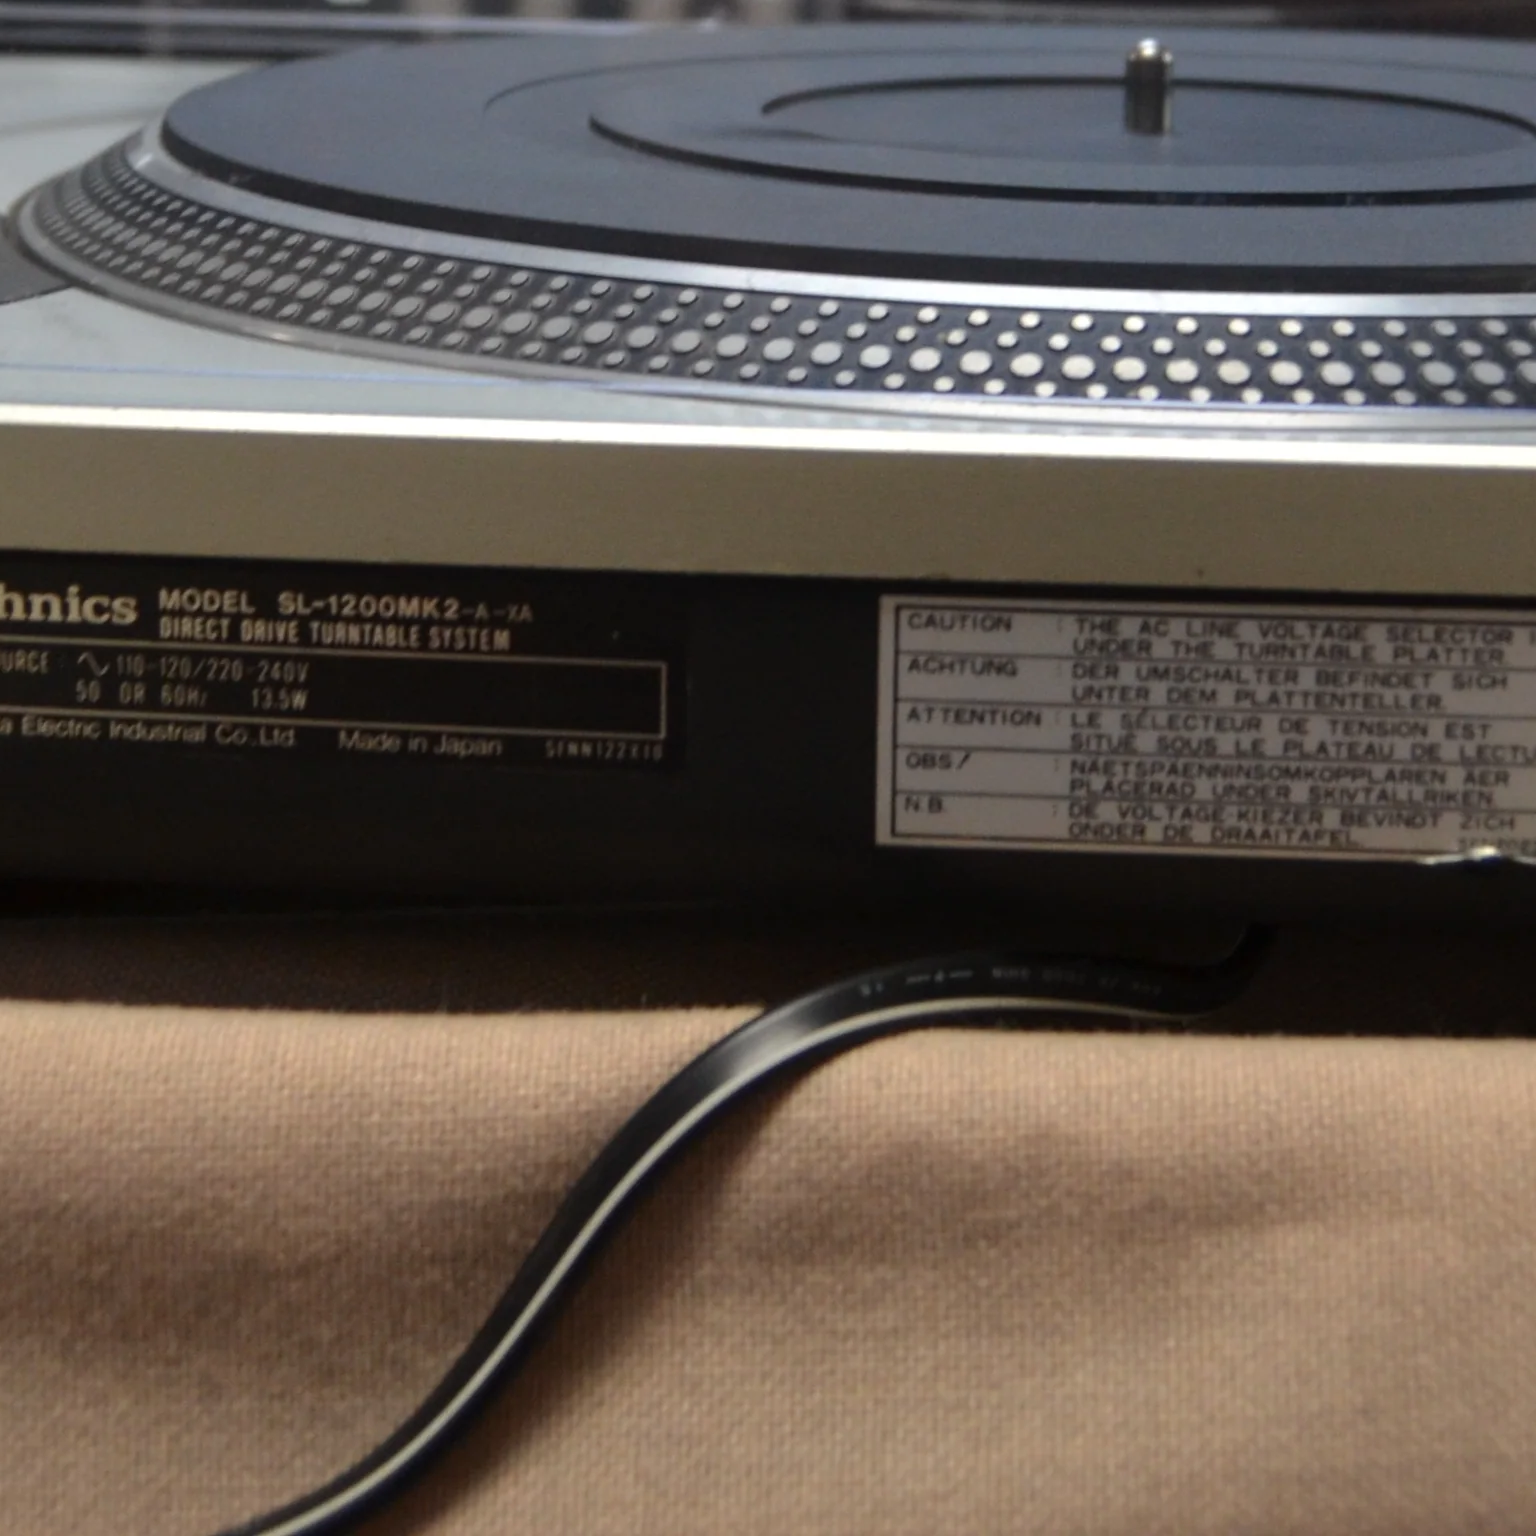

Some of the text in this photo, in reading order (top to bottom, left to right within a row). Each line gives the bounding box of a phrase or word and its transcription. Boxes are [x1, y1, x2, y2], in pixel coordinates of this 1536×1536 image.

[158, 586, 256, 615] MODEL
[159, 616, 512, 652] DIRECT DRIVE TURNTABLE SYSTEM
[907, 612, 1012, 634] CAUTION
[1075, 616, 1120, 636] THE
[1138, 618, 1170, 637] AC
[1185, 619, 1238, 639] LINE
[1259, 621, 1368, 641] VOLTAGE
[1387, 625, 1514, 646] SELECTOR
[1072, 638, 1153, 657] UNDER
[1170, 640, 1215, 658] THE
[1235, 641, 1376, 663] TURNTABLE
[907, 657, 1509, 691] ACHTUNG DER UMSCHALTER BEFINDET SICH
[74, 679, 101, 704] 50
[119, 680, 147, 706] OR
[1072, 684, 1151, 704] UNTER
[1166, 686, 1218, 705] DEM
[20, 712, 102, 739] Electric
[109, 716, 207, 743] Industrial
[337, 729, 401, 754] Made
[408, 732, 428, 755] in
[433, 733, 504, 759] Japan
[906, 705, 1043, 727] ATTENTION
[1070, 710, 1103, 729] LE
[1278, 715, 1310, 735] DE
[1329, 718, 1429, 739] TENSION
[1444, 721, 1493, 740] EST
[1235, 739, 1267, 758] LE
[1283, 740, 1395, 762] PLATEAU
[1410, 742, 1442, 762] DE
[1070, 779, 1197, 799] PLACERAD
[1212, 782, 1292, 802] UNDER
[1068, 801, 1100, 819] DE
[1340, 810, 1443, 830] BEVINDT
[1459, 814, 1517, 832] ZICH
[1068, 822, 1147, 841] ONDER
[1163, 824, 1194, 842] DE
